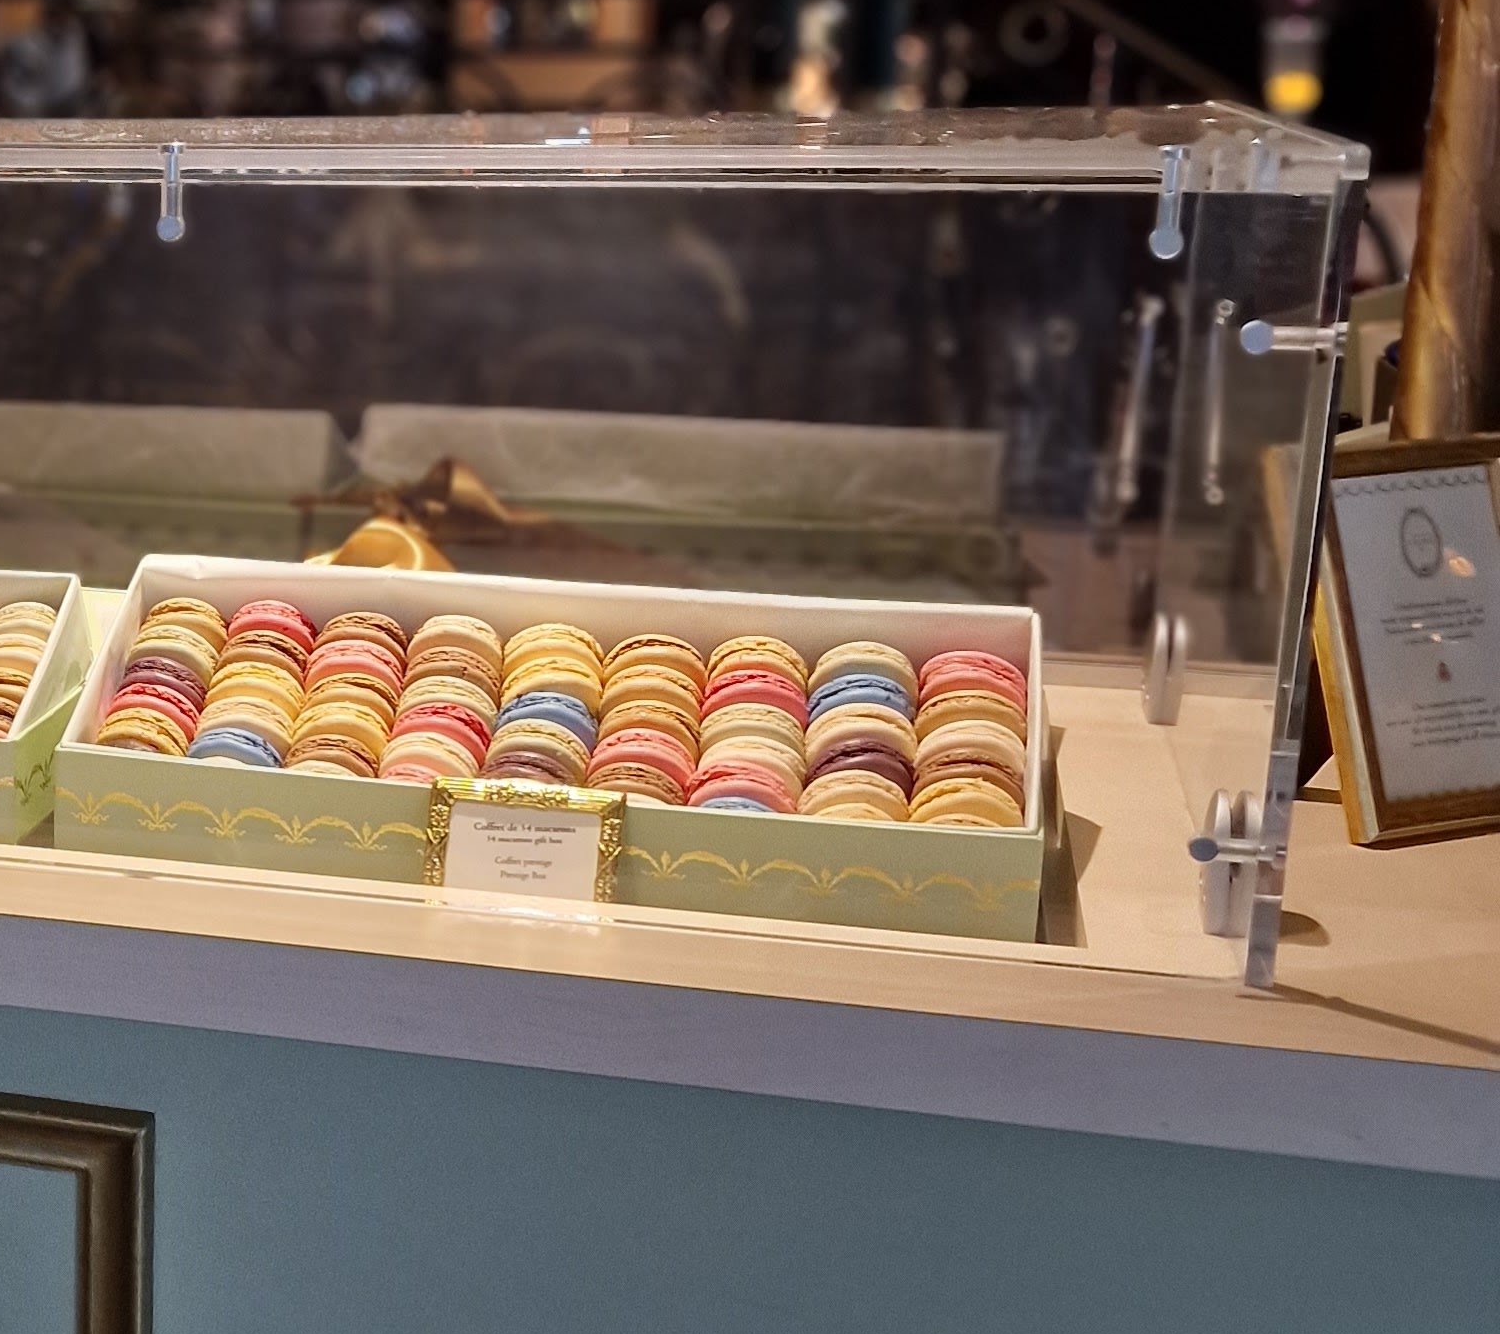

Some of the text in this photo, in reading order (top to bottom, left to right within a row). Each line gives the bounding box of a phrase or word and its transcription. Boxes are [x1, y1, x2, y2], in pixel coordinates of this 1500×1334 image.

[473, 821, 505, 833] Coffret
[507, 822, 518, 833] de
[494, 856, 522, 866] Coffret
